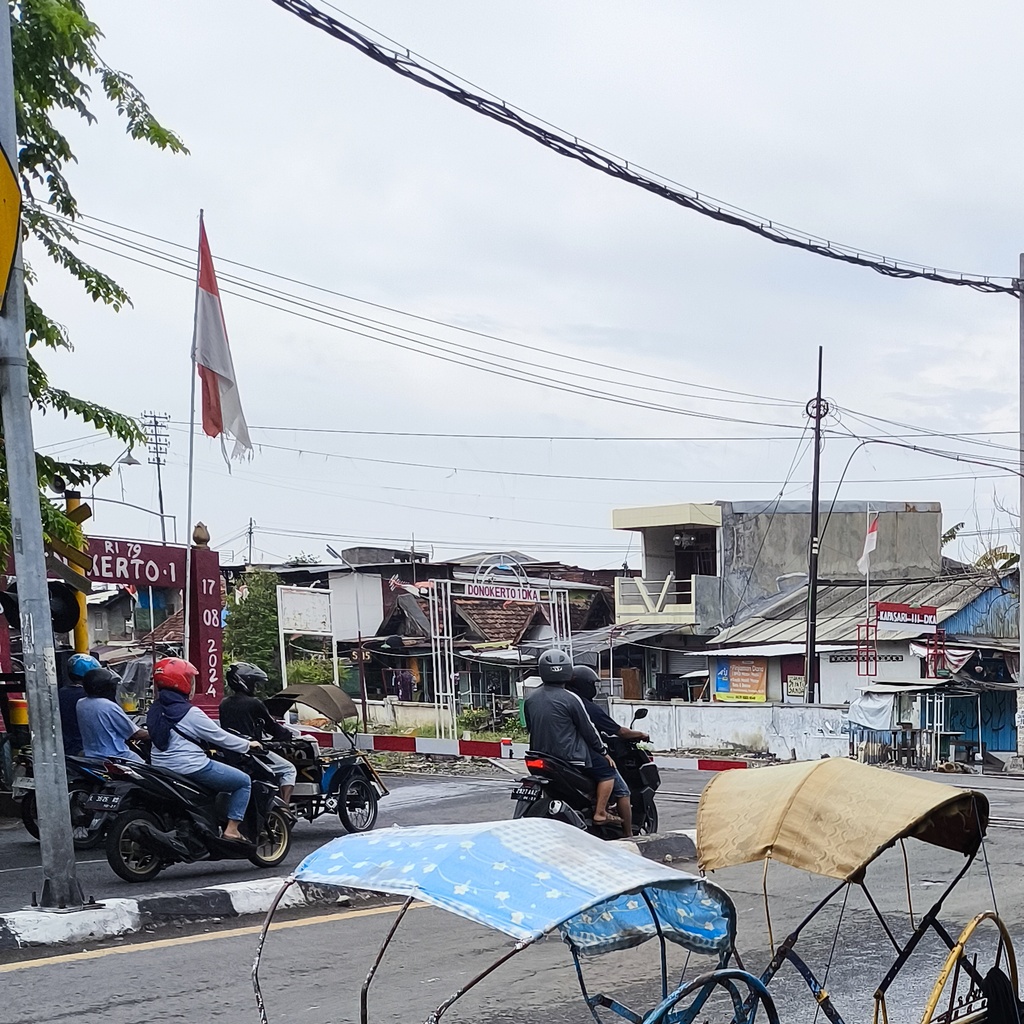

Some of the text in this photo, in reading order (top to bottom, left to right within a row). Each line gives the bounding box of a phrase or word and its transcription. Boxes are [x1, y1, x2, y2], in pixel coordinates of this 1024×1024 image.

[104, 540, 142, 558] RI 79
[202, 579, 216, 595] 17
[468, 585, 516, 599] DONOKERTO
[203, 609, 220, 627] 08
